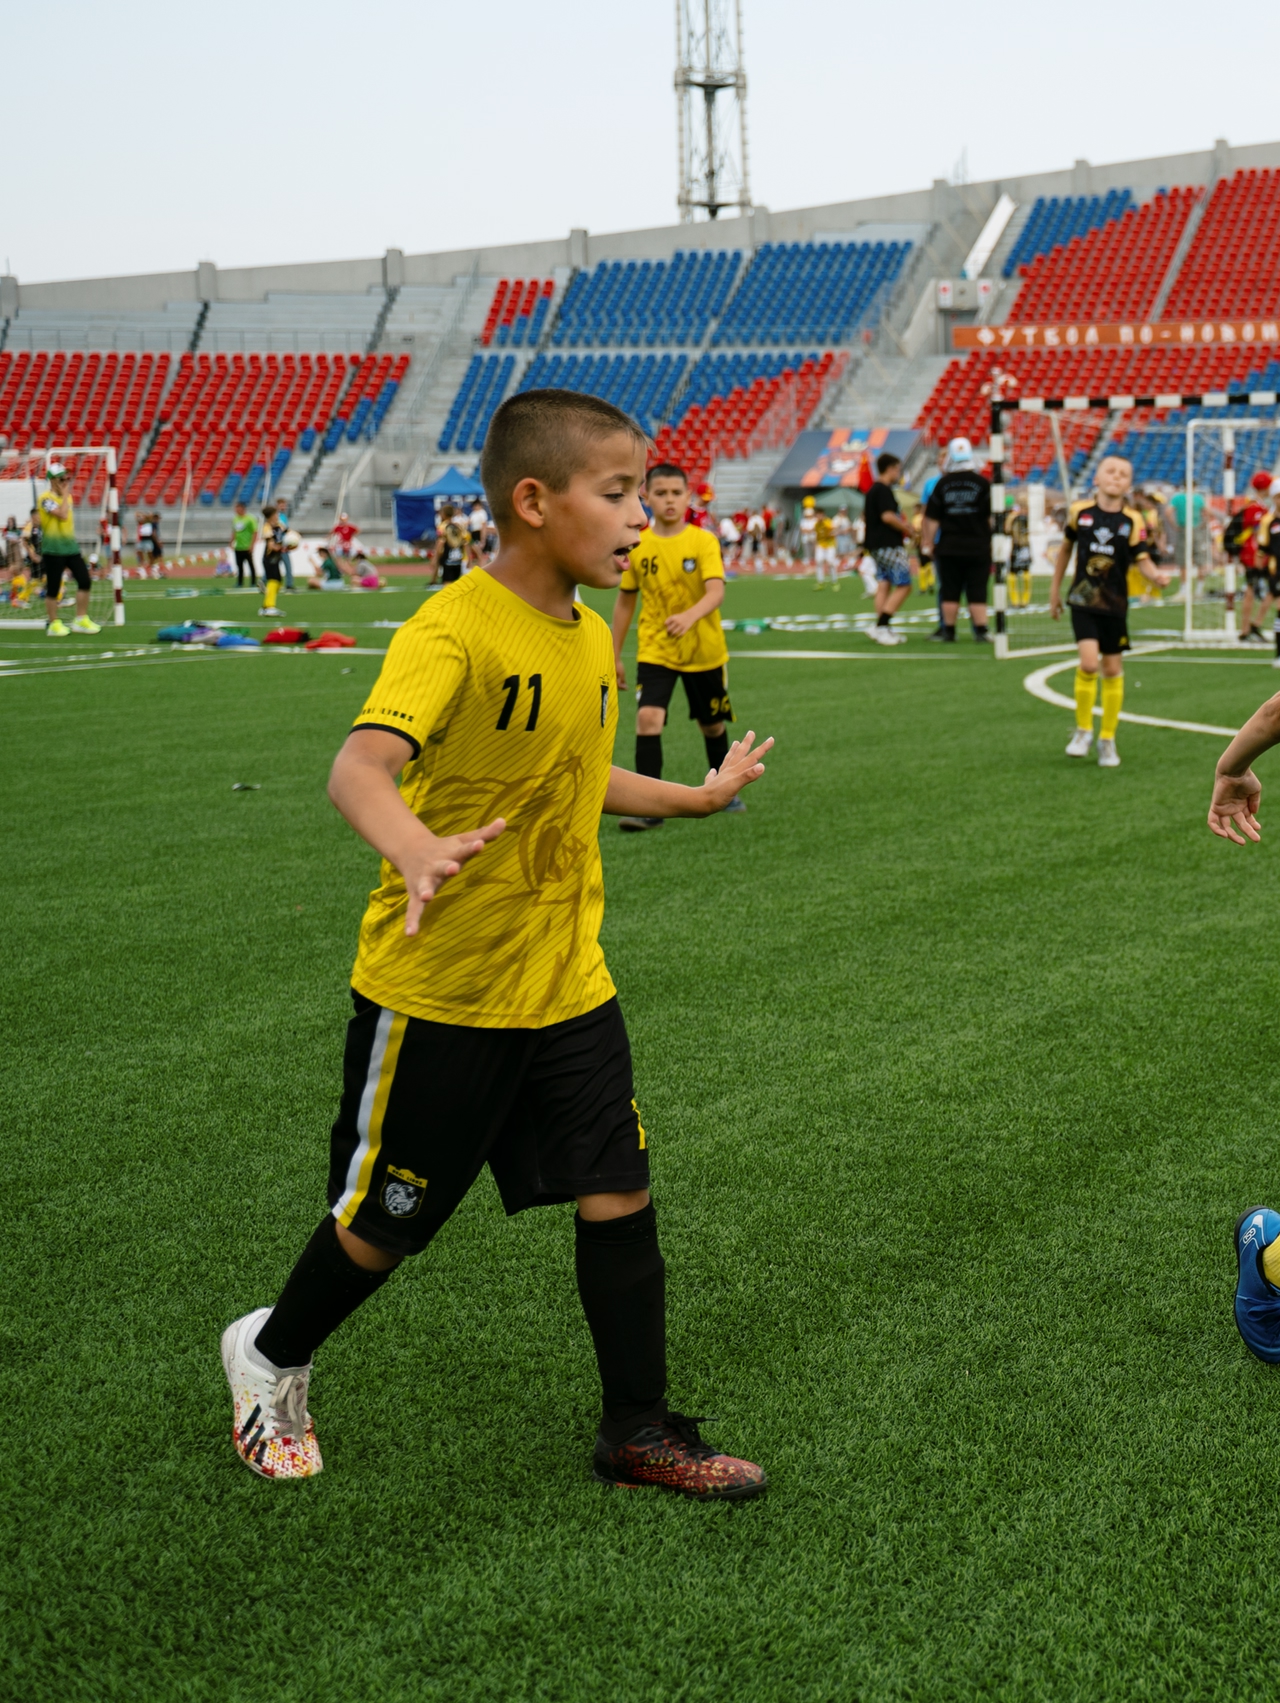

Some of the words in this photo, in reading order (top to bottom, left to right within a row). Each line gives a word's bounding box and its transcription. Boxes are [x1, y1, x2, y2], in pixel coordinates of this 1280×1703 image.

[976, 325, 1099, 347] ФУТБОЛ
[641, 556, 659, 578] 96
[495, 673, 542, 732] 11
